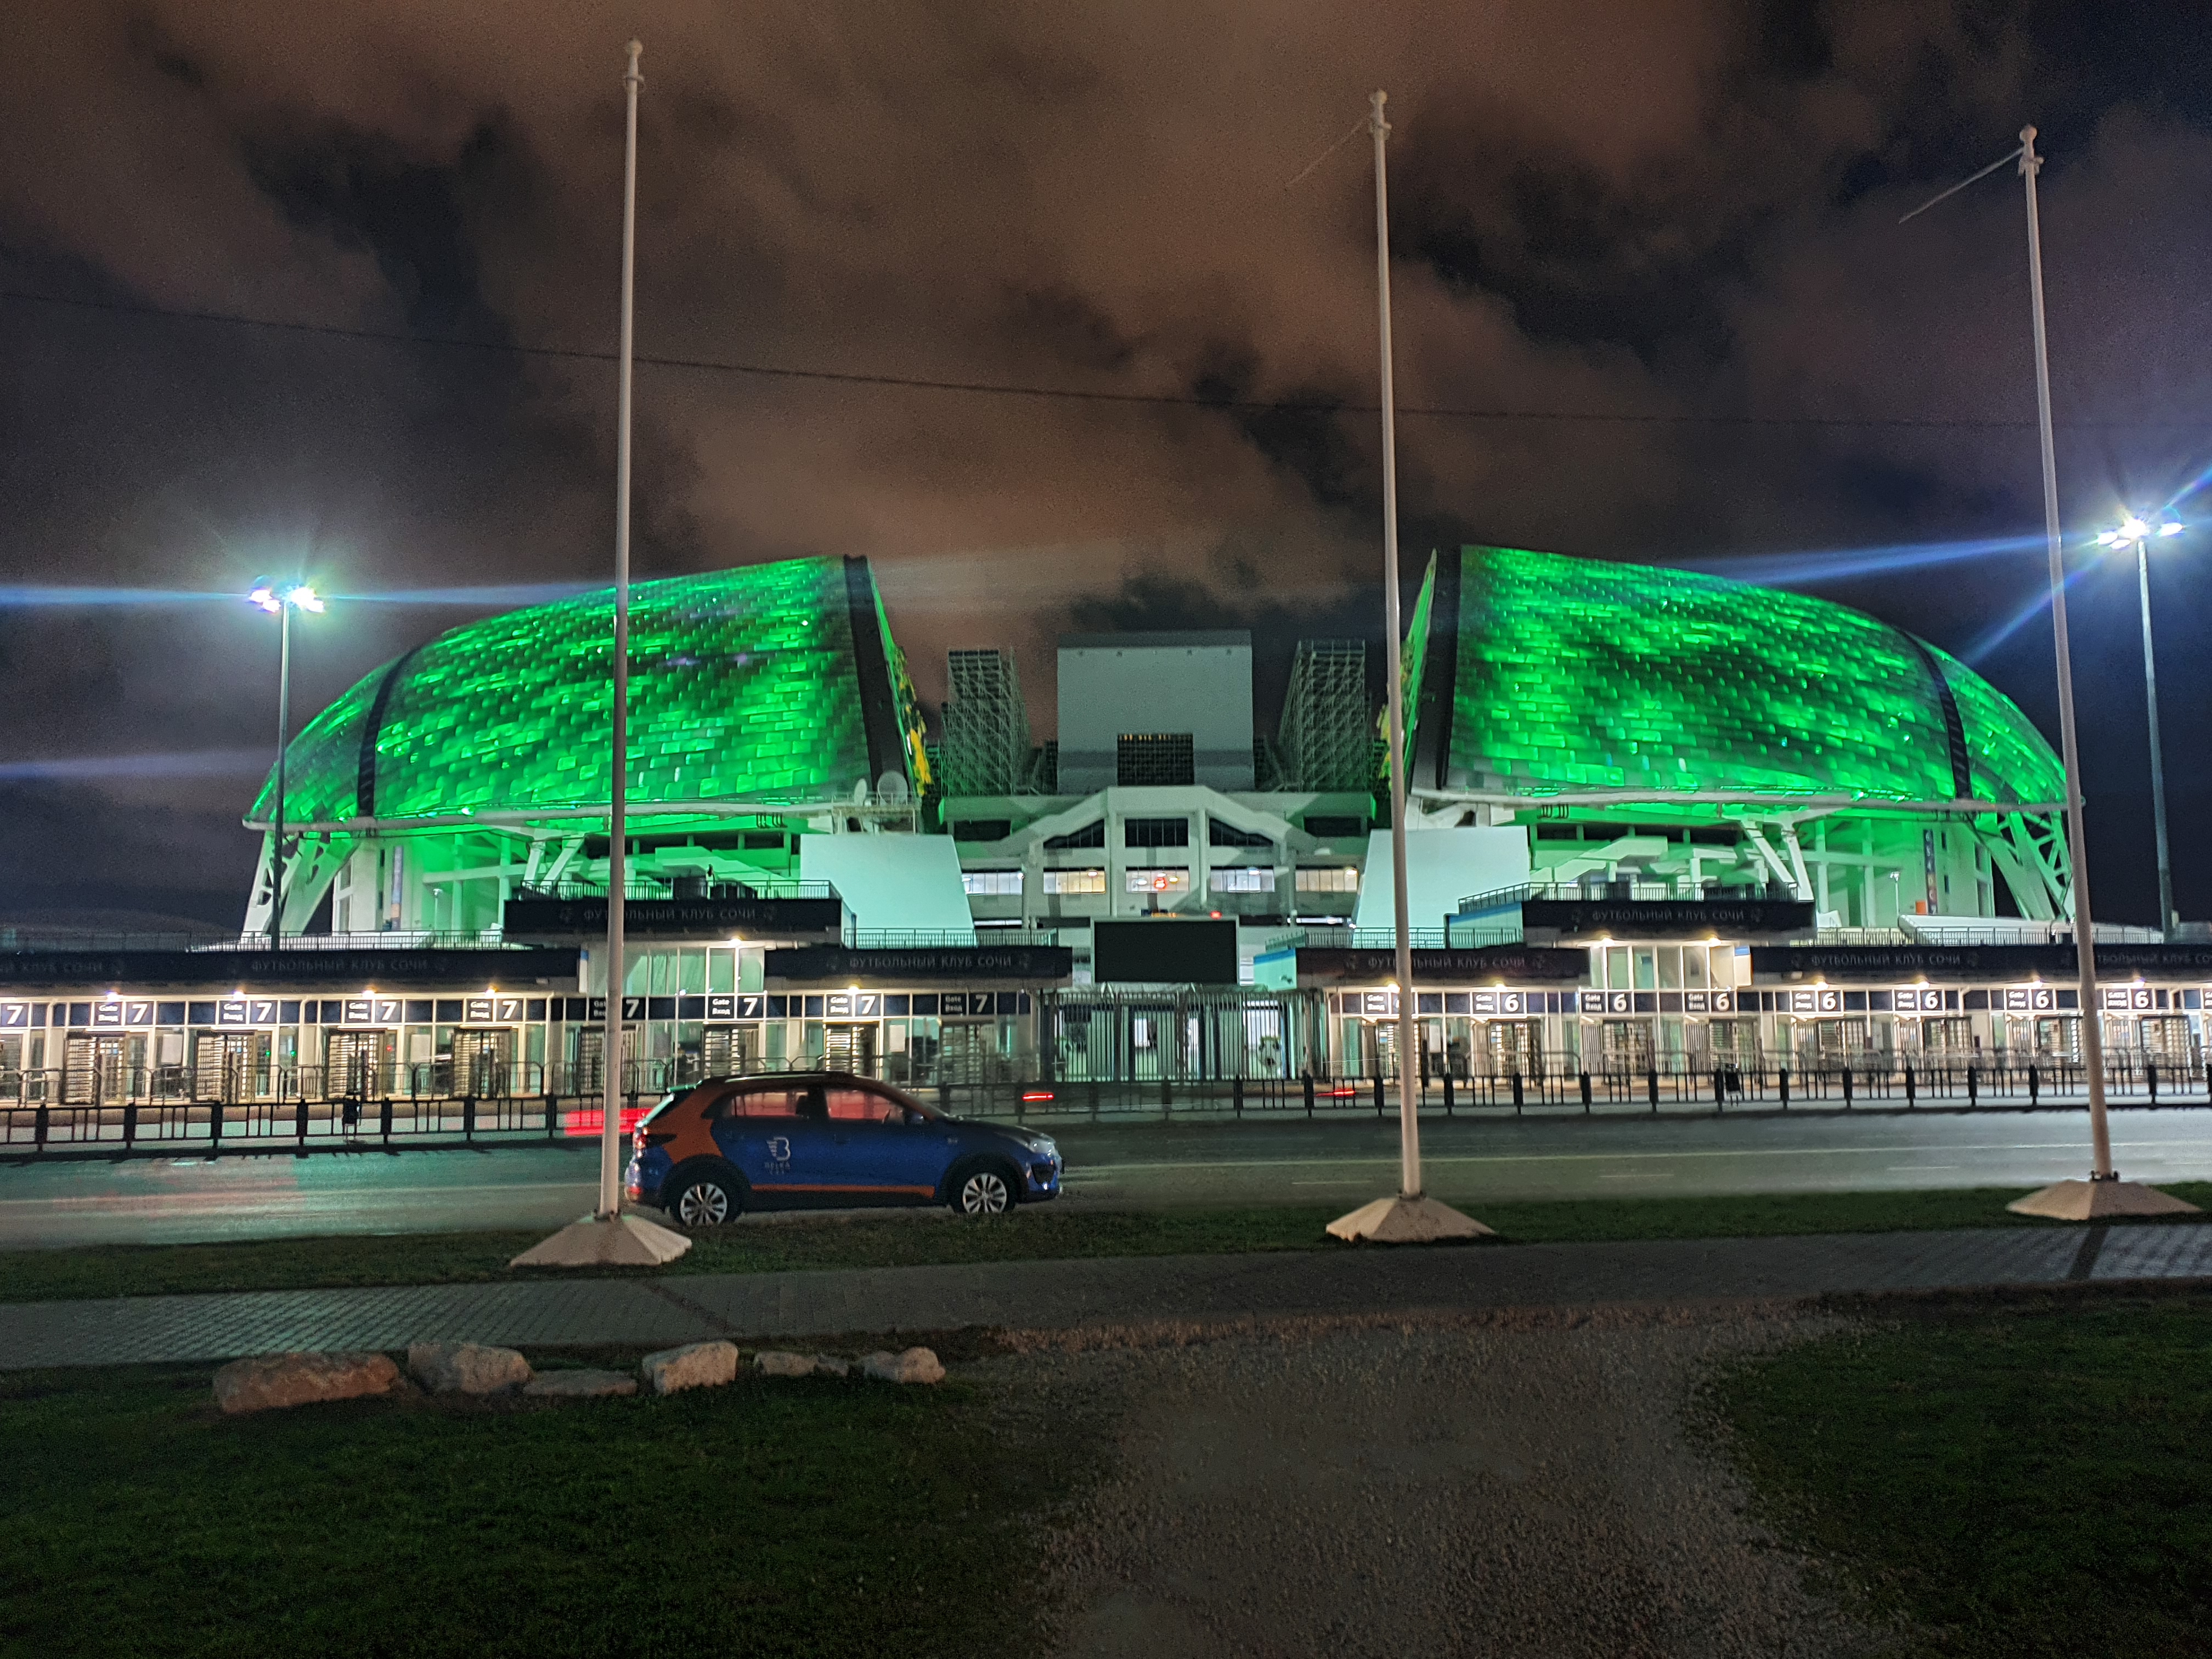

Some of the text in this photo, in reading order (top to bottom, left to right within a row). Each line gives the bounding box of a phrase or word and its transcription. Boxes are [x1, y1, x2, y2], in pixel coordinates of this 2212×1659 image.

[583, 908, 675, 921] ФУЛЬНЫЙ
[719, 908, 755, 921] СОЧИ
[1712, 910, 1744, 921] СОЧИ
[849, 956, 1012, 968] ФУТБОЛЬНЫЙ КЛУБ СОЧИ
[1368, 956, 1525, 969] ФУТЬНЫЙ КЛУБ СОЧИ
[1811, 953, 1961, 966] ФУТБОЛЬНЫЙ КЛУБ СОЧИ
[625, 999, 639, 1018] 7
[743, 997, 758, 1016] 7
[861, 996, 875, 1014] 7
[975, 994, 988, 1013] 7
[1505, 994, 1519, 1012] 6
[1613, 994, 1627, 1012] 6
[1716, 992, 1729, 1011] 6
[1822, 992, 1836, 1009] 6
[1925, 991, 1938, 1009] 6
[2036, 991, 2049, 1008] 6
[2135, 991, 2149, 1008] 6
[7, 1005, 24, 1024] 7
[132, 1003, 148, 1023] 7
[256, 1003, 272, 1022] 7
[381, 1002, 397, 1020] 7
[502, 1000, 517, 1019] 7
